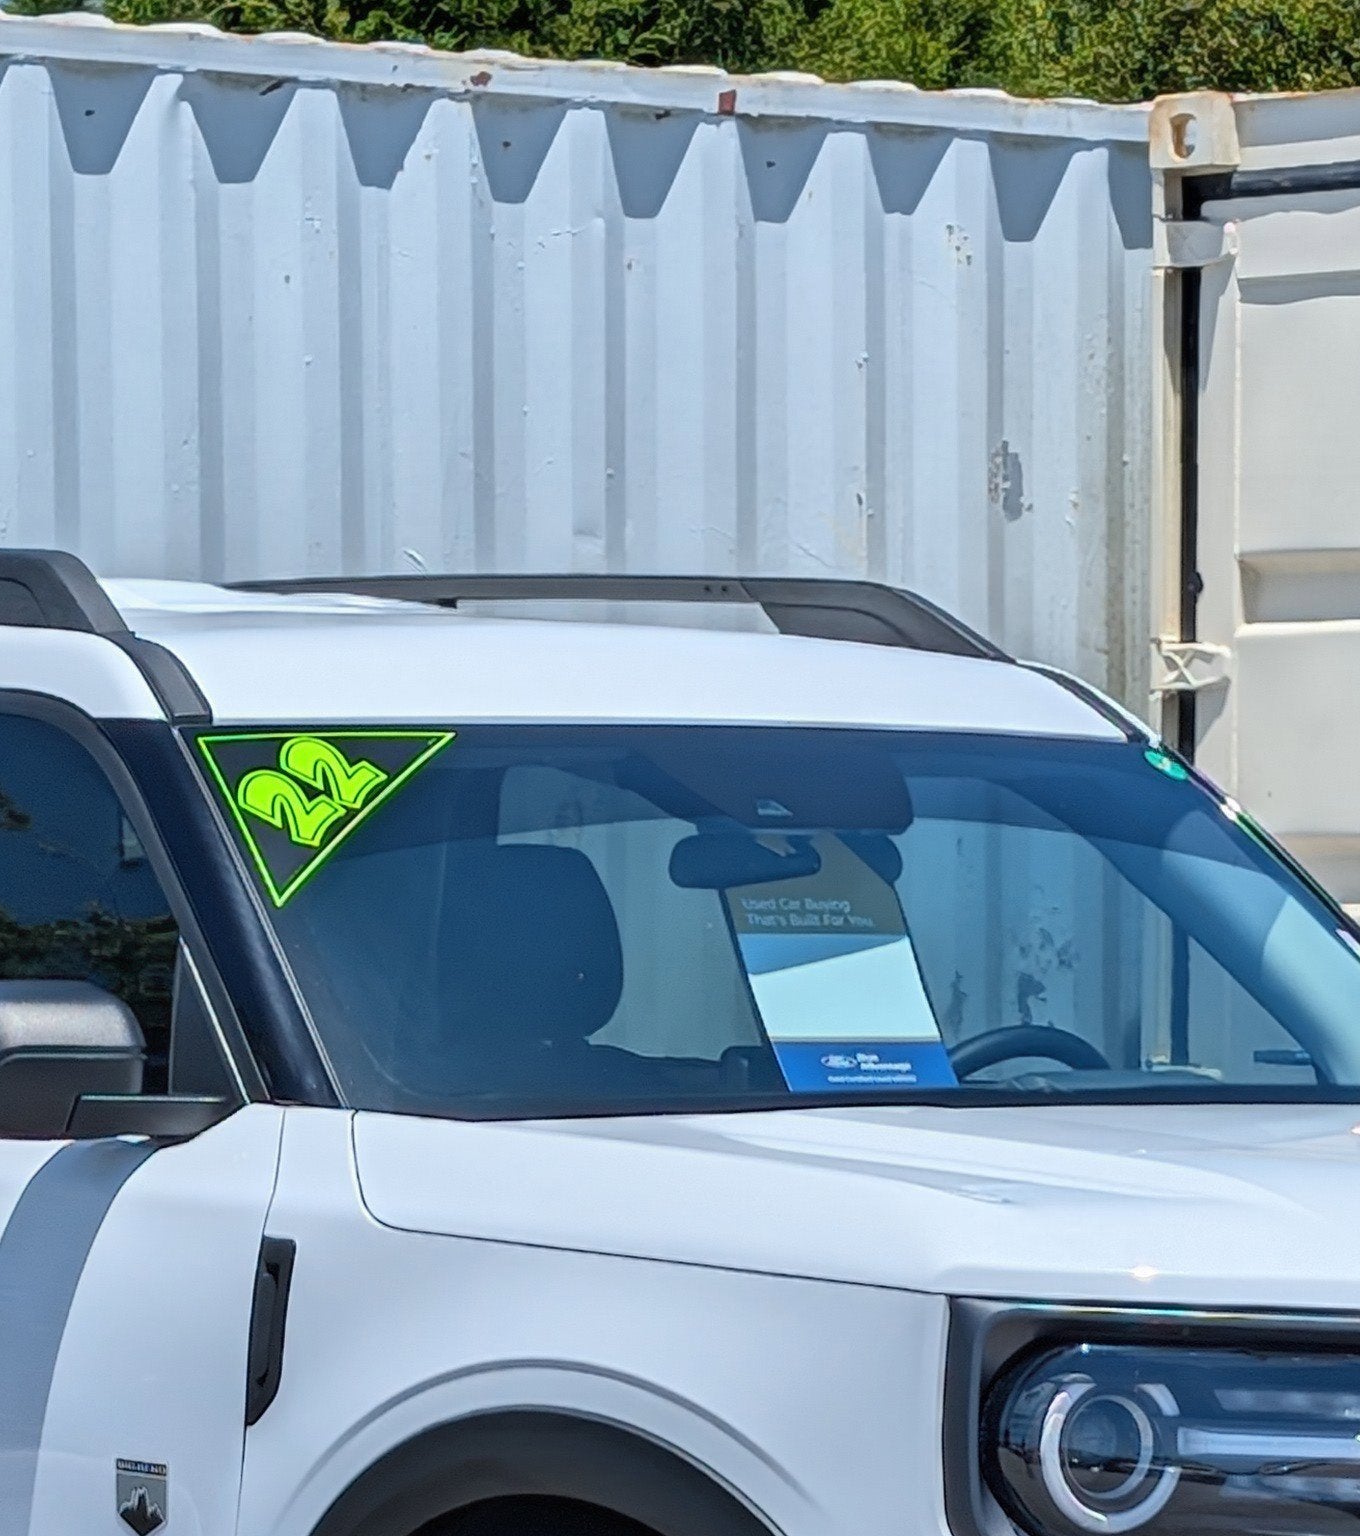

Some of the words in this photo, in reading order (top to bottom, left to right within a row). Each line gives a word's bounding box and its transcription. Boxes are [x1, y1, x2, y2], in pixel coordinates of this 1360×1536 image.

[237, 736, 388, 847] 22
[803, 898, 852, 915] Buying
[823, 914, 845, 926] For
